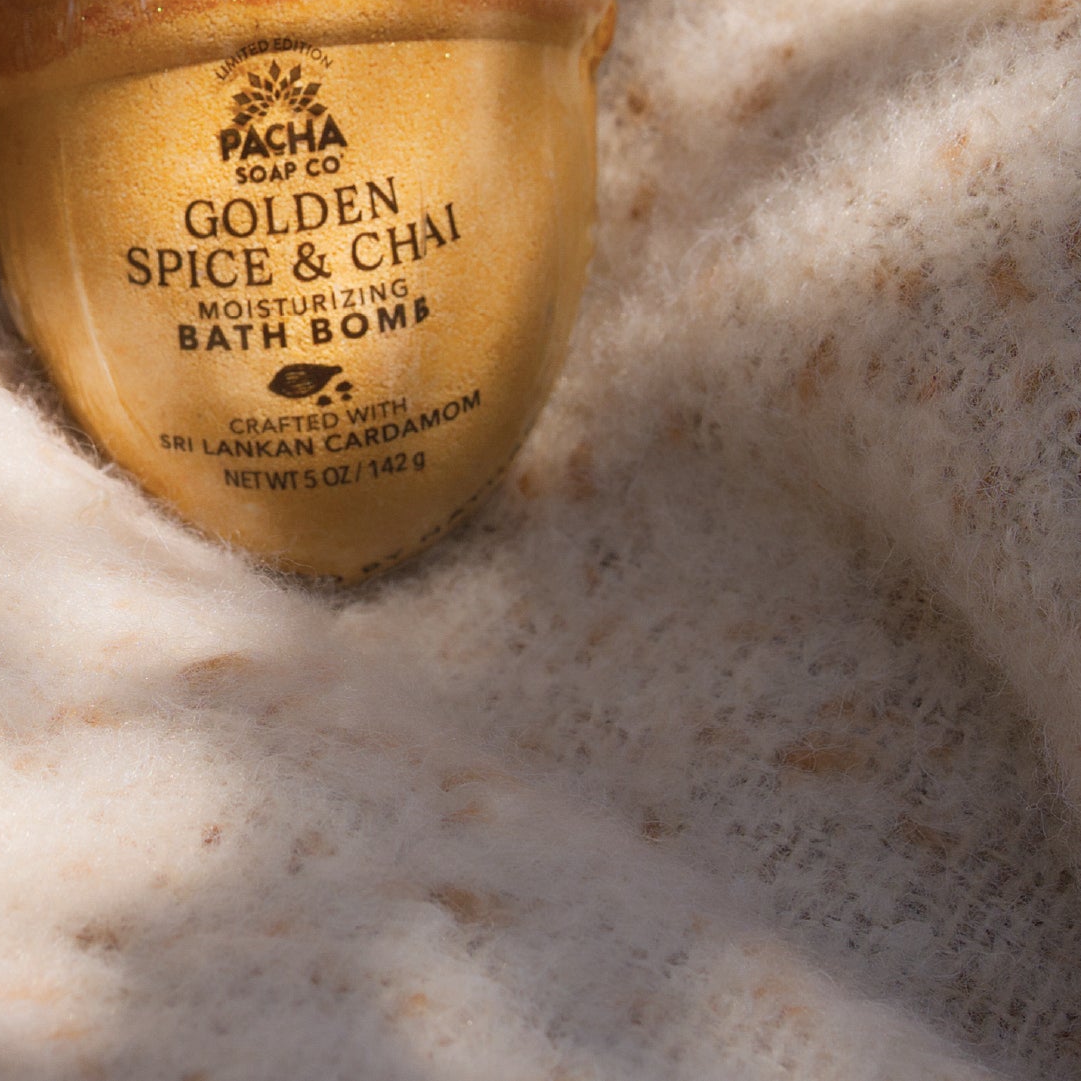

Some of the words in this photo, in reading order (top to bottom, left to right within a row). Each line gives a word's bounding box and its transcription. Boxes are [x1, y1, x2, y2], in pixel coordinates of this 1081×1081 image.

[215, 39, 270, 81] LIMITED
[273, 37, 334, 69] EDITION
[219, 113, 348, 161] PACHA
[235, 161, 297, 184] SOAP
[305, 155, 341, 177] CO
[184, 176, 400, 240] GOLDEN
[126, 245, 273, 288] SPICE
[292, 241, 332, 282] &
[350, 202, 461, 272] CHAI
[197, 278, 409, 321] MOISTURIZING
[177, 321, 288, 352] BATH
[310, 296, 430, 345] BOMB
[159, 433, 194, 453] SRI
[202, 437, 314, 459] LANKAN
[323, 388, 482, 454] CARDAMOM
[228, 410, 339, 435] CRAFTED
[345, 397, 408, 426] WITH
[224, 468, 261, 489] NET
[267, 470, 299, 491] WT
[303, 469, 318, 489] 5
[322, 465, 352, 487] OZ
[368, 452, 407, 479] 142
[413, 450, 427, 473] g
